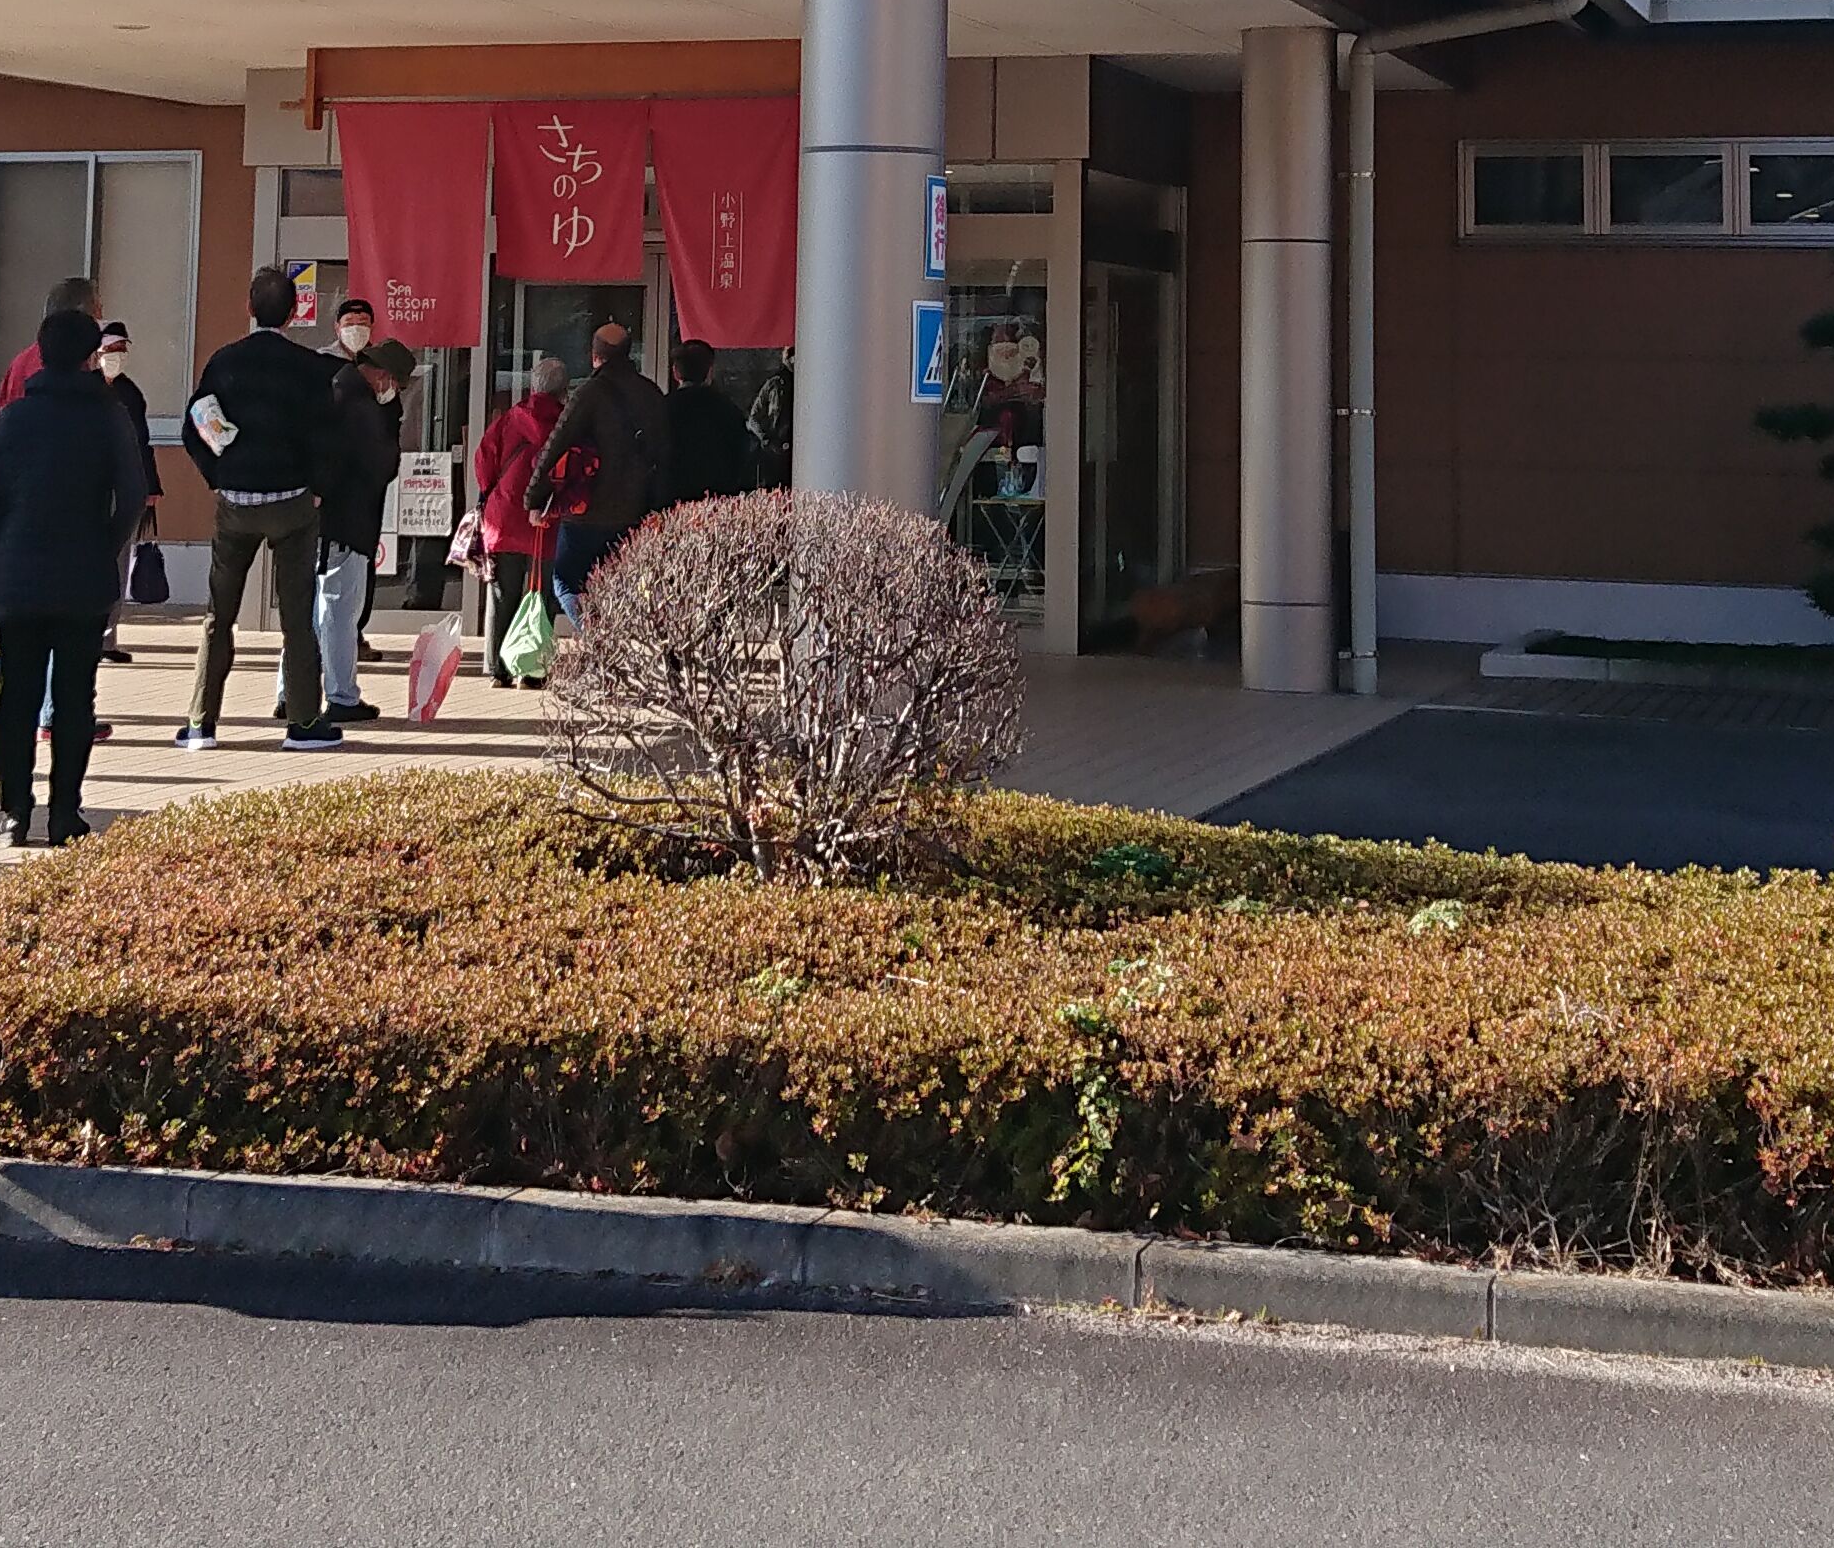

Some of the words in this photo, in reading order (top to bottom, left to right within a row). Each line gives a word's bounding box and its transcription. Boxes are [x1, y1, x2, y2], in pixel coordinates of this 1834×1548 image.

[536, 114, 603, 259] さちのゆ
[719, 191, 737, 289] 小野上温泉
[386, 298, 437, 310] RESORT
[387, 310, 425, 322] SACHI
